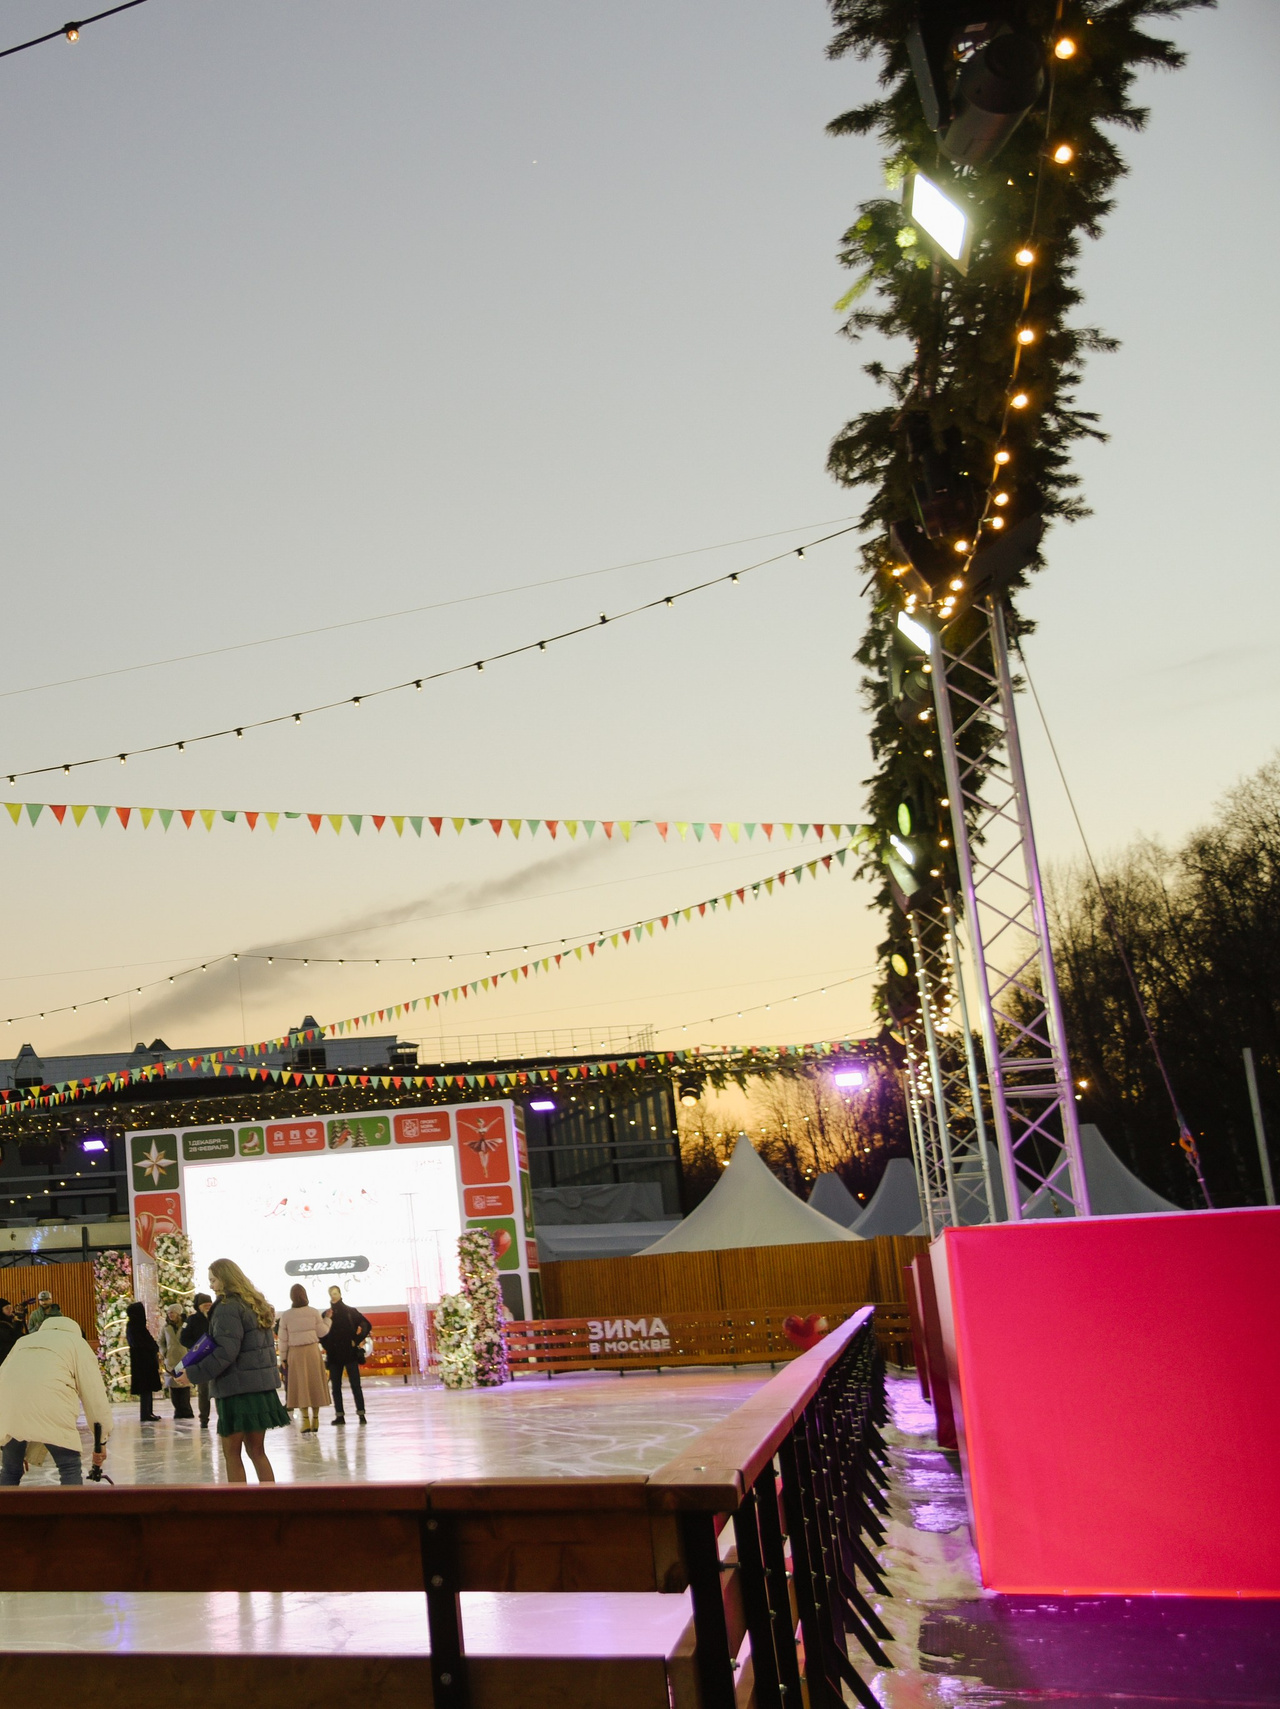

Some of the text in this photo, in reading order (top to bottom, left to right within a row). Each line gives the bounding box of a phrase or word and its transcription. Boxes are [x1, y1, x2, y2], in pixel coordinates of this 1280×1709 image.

[191, 1138, 221, 1146] ДЕКАБРЯ
[298, 1260, 356, 1272] 25.02.2025
[587, 1317, 669, 1340] ЗИМА
[589, 1338, 671, 1353] В МОСКВЕ
